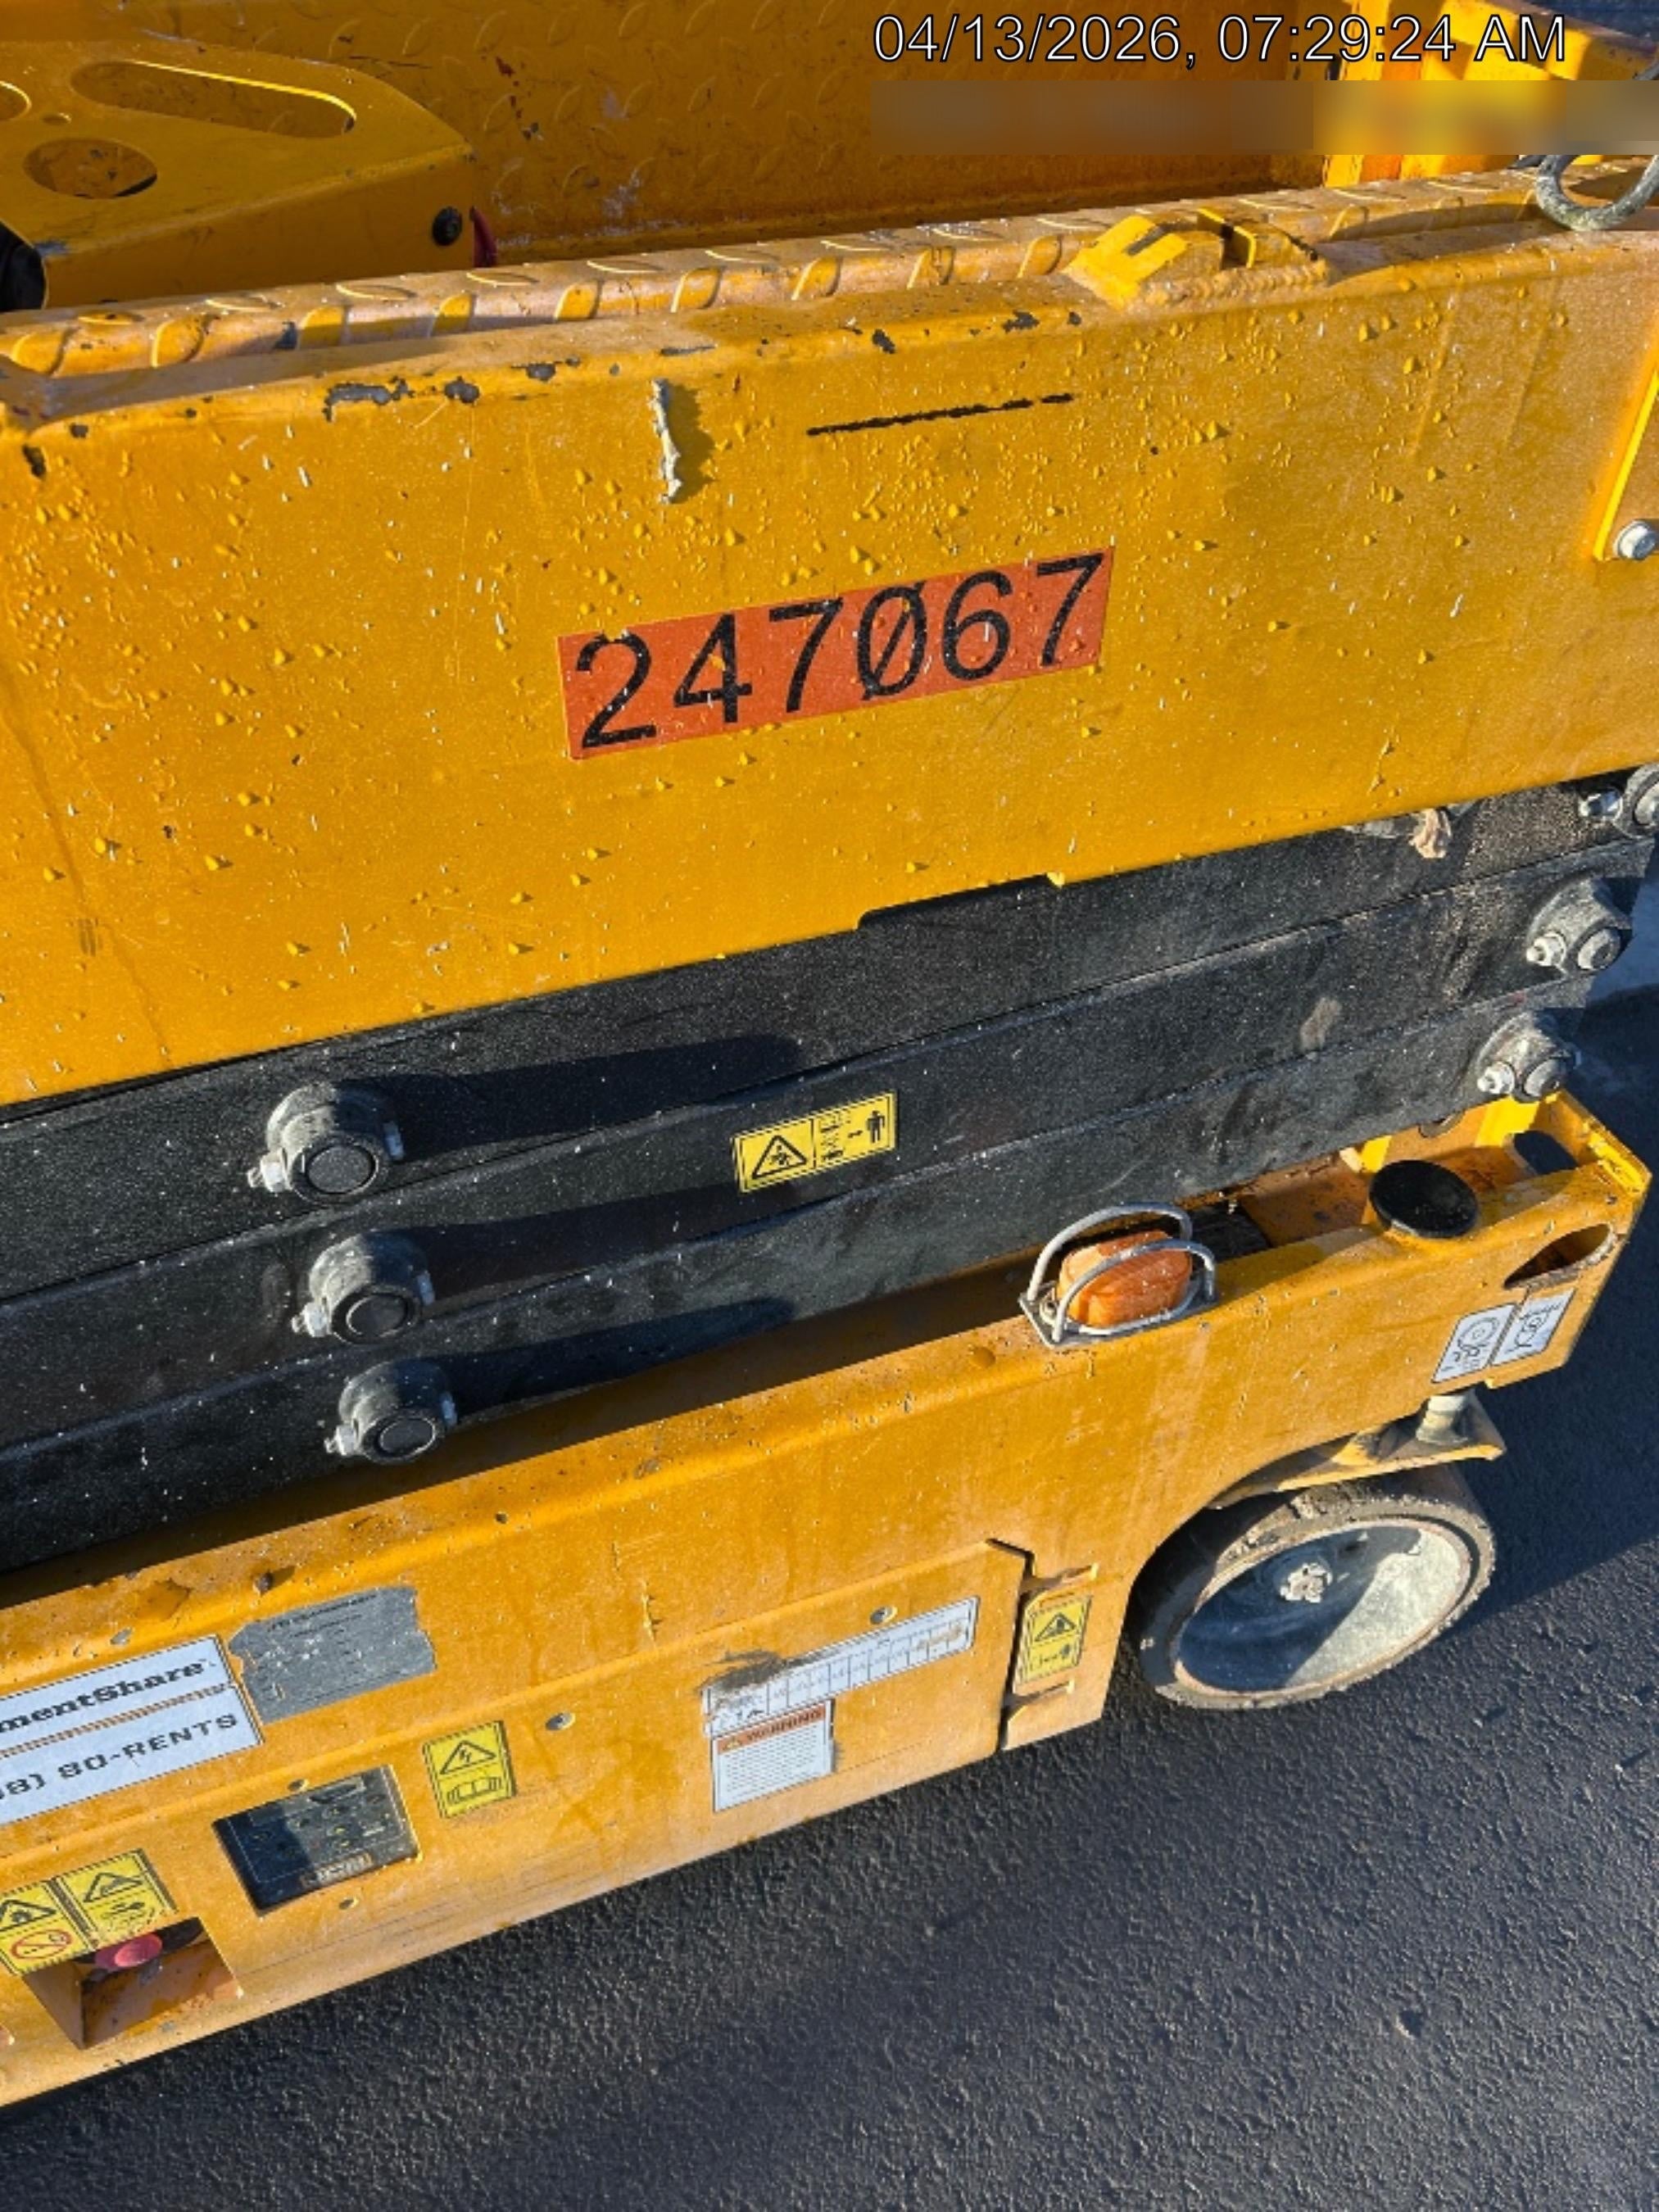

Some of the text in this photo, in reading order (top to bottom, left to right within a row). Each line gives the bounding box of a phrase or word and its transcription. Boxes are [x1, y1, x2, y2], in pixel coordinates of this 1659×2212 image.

[575, 552, 1104, 749] 247067
[0, 1712, 238, 1801] 8) 80-RENTS
